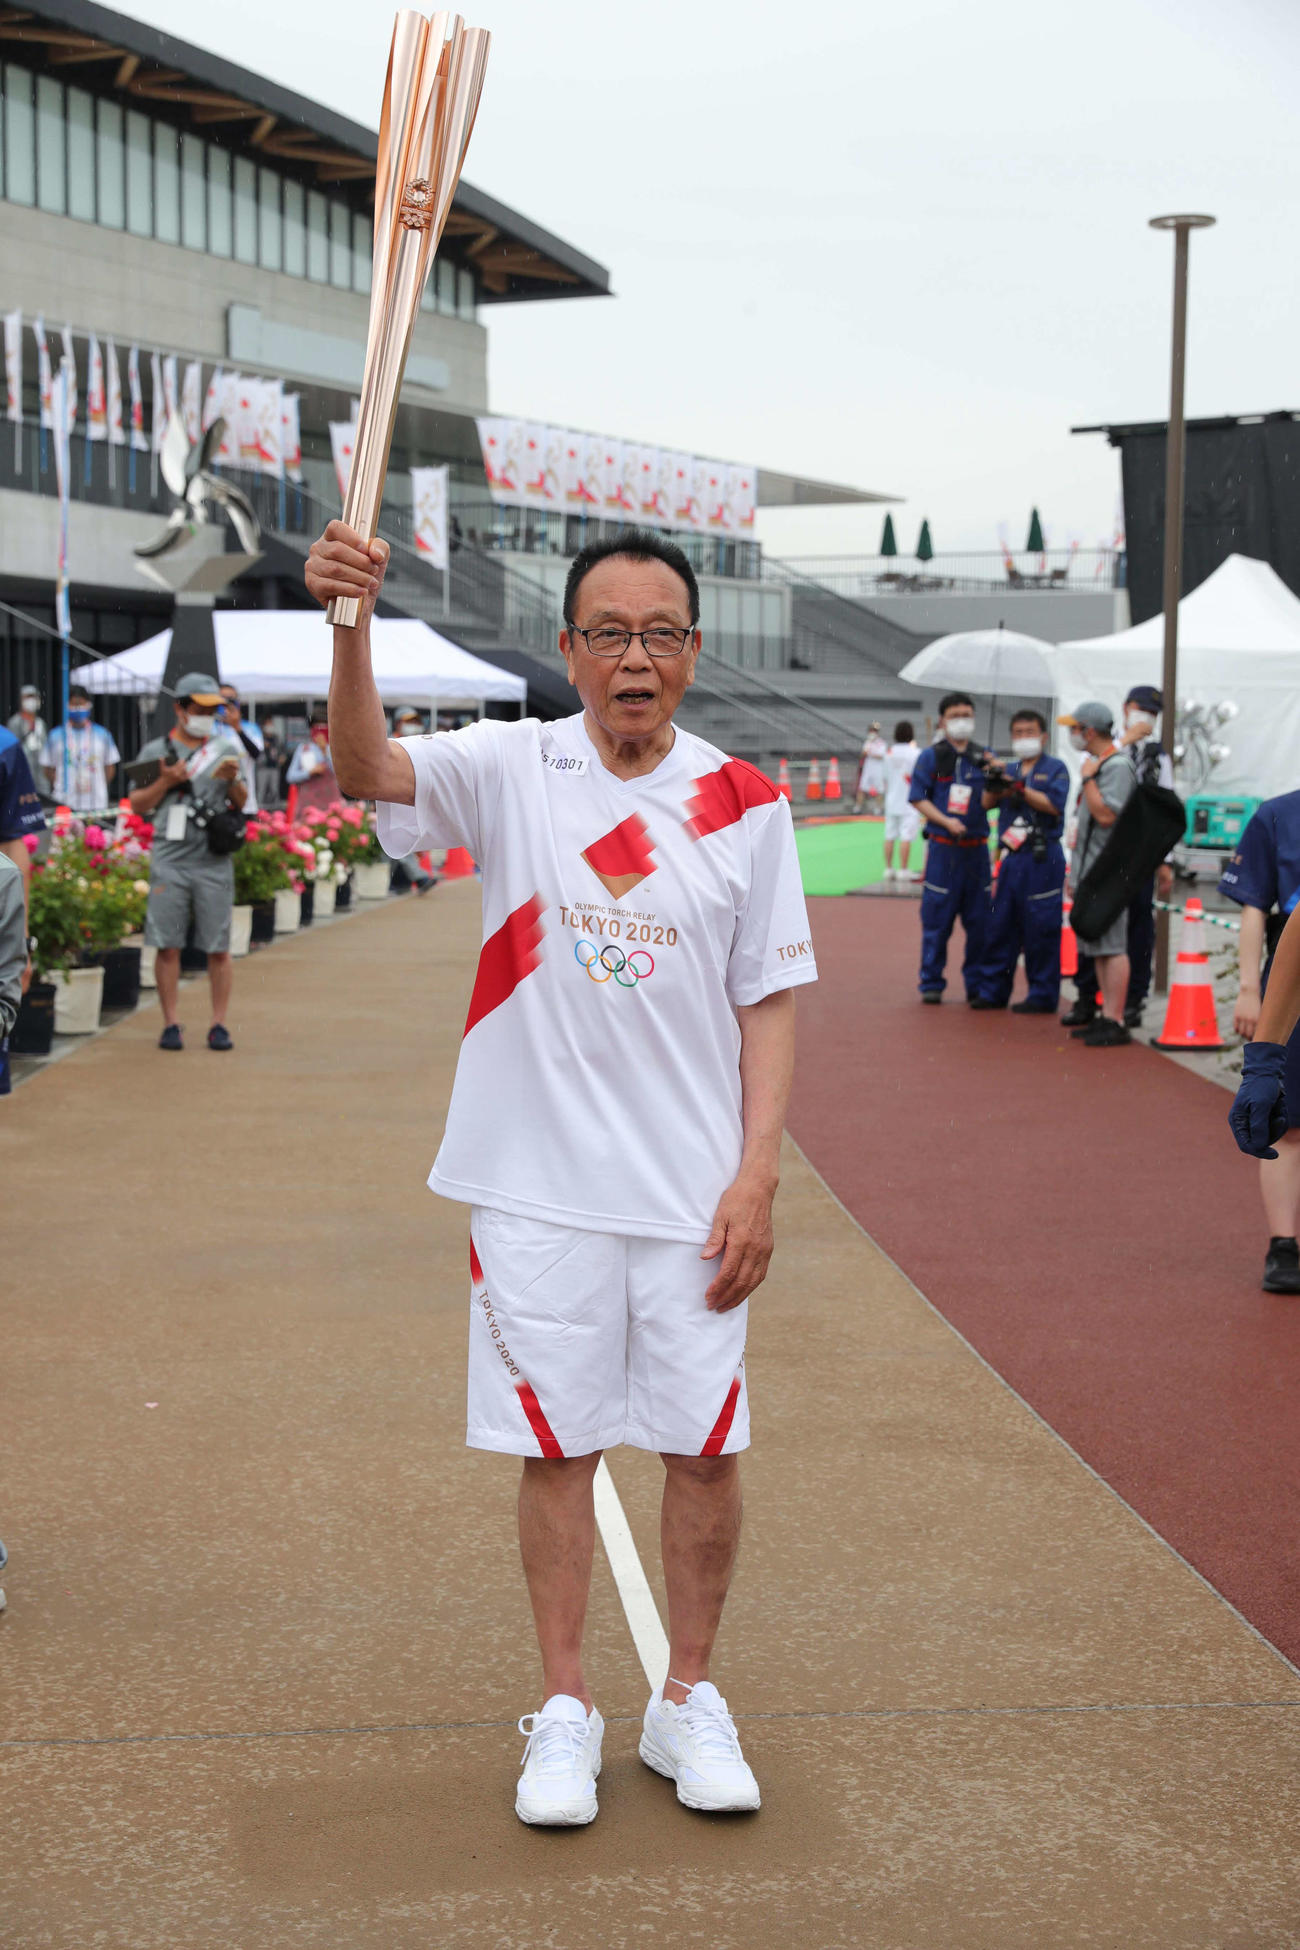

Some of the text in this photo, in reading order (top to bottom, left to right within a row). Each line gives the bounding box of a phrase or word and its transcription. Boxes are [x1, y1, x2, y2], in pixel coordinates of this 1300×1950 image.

[541, 748, 583, 771] 510301
[560, 906, 678, 946] TOKYO 2020
[575, 902, 656, 921] OLYMPIC TORCH RELAY
[479, 1289, 520, 1376] TOKYO 2020
